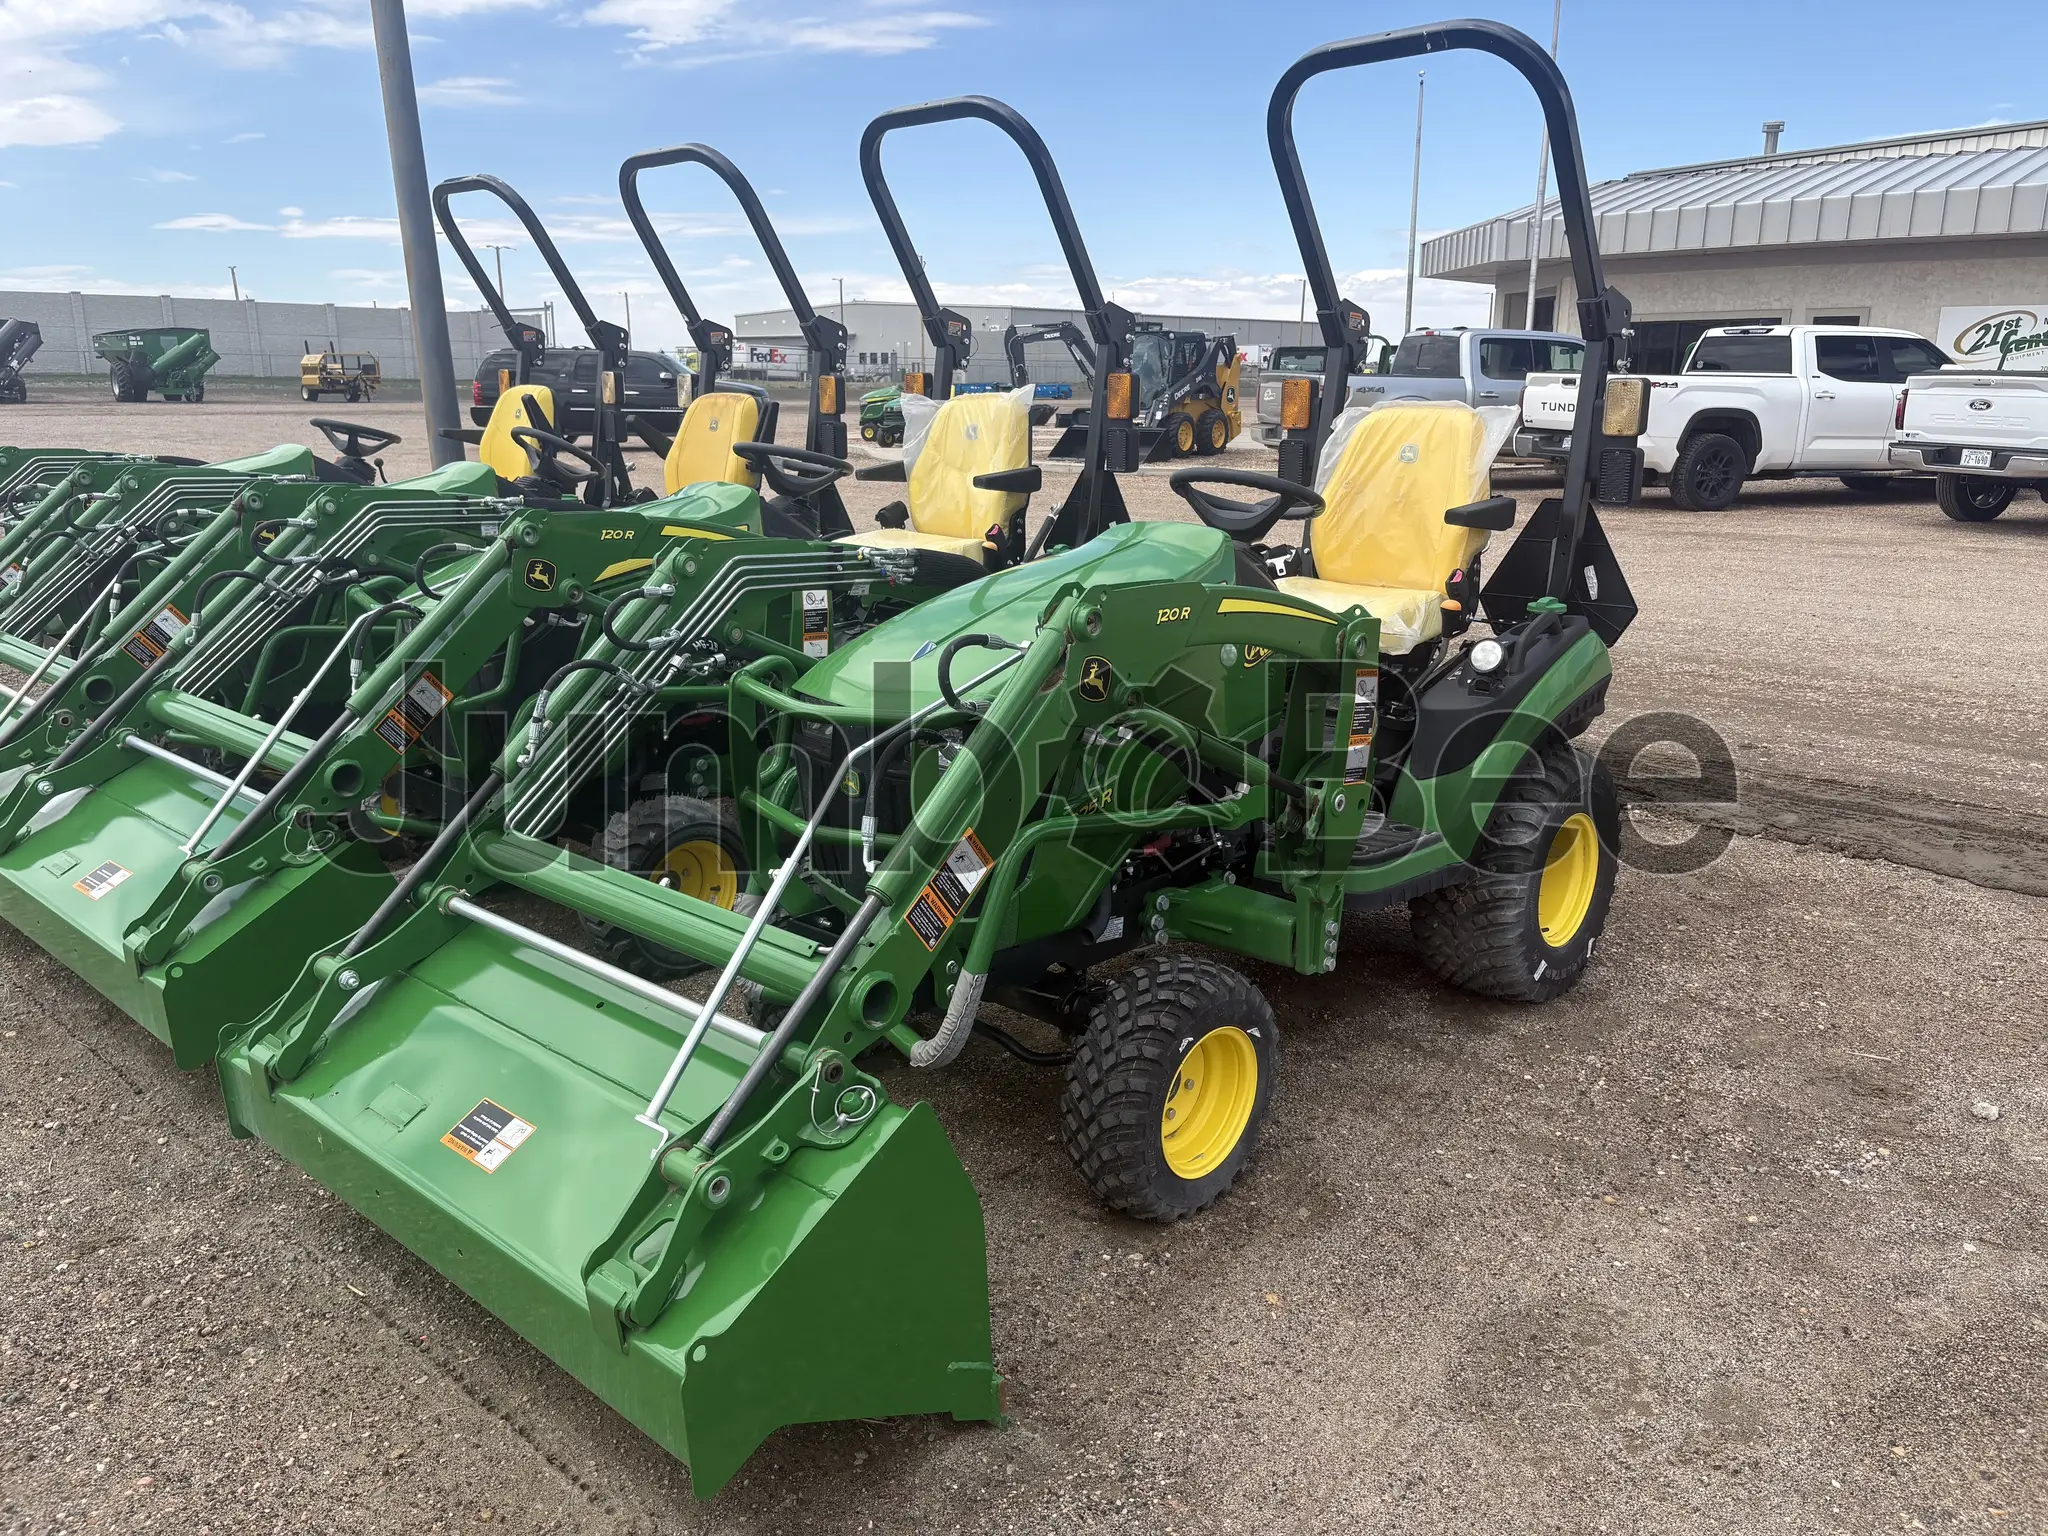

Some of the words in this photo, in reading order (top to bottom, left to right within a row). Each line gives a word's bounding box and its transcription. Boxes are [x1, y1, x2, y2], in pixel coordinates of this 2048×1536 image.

[1044, 332, 1060, 340] DEERE
[1965, 317, 2023, 356] 21st
[750, 347, 787, 364] FedEx
[1541, 402, 1575, 413] TUND
[971, 839, 990, 865] WARNING
[930, 896, 949, 924] WARNING
